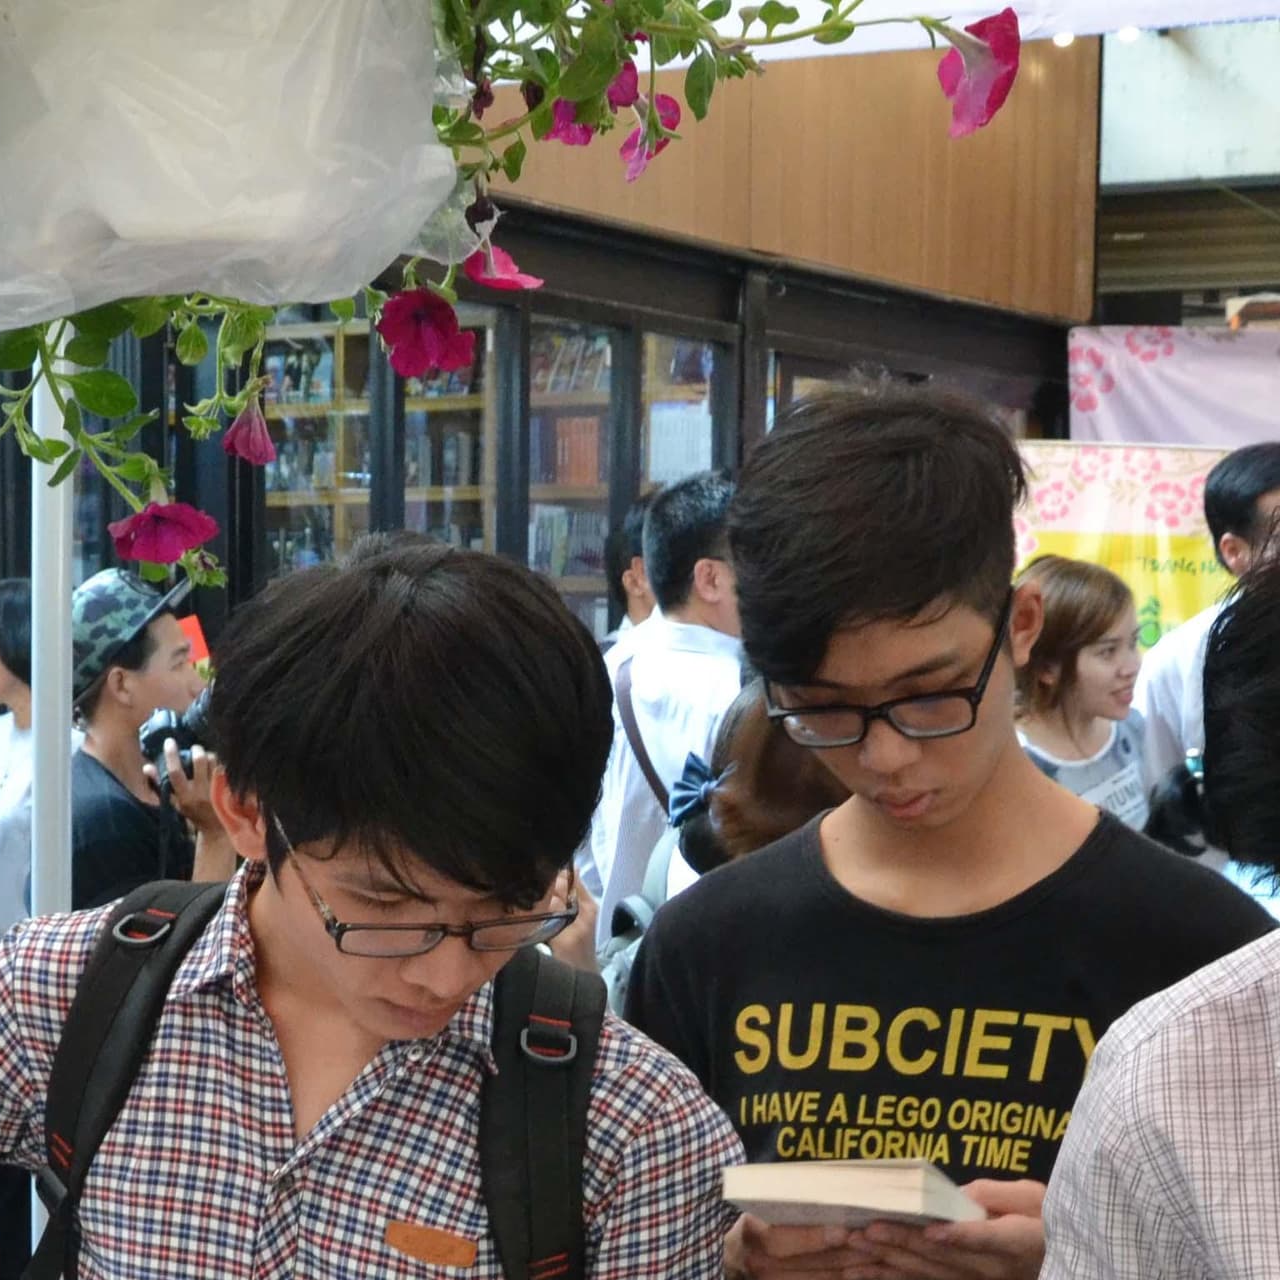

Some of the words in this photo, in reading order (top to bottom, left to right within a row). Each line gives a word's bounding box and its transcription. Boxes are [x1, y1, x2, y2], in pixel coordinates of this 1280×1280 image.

[740, 1096, 748, 1126] I
[752, 1091, 821, 1126] HAVE
[826, 1094, 848, 1125] A
[857, 1094, 941, 1129] LEGO
[947, 1098, 1071, 1141] ORIGINA
[776, 1126, 950, 1165] CALIFORNIA
[961, 1135, 1032, 1173] TIME
